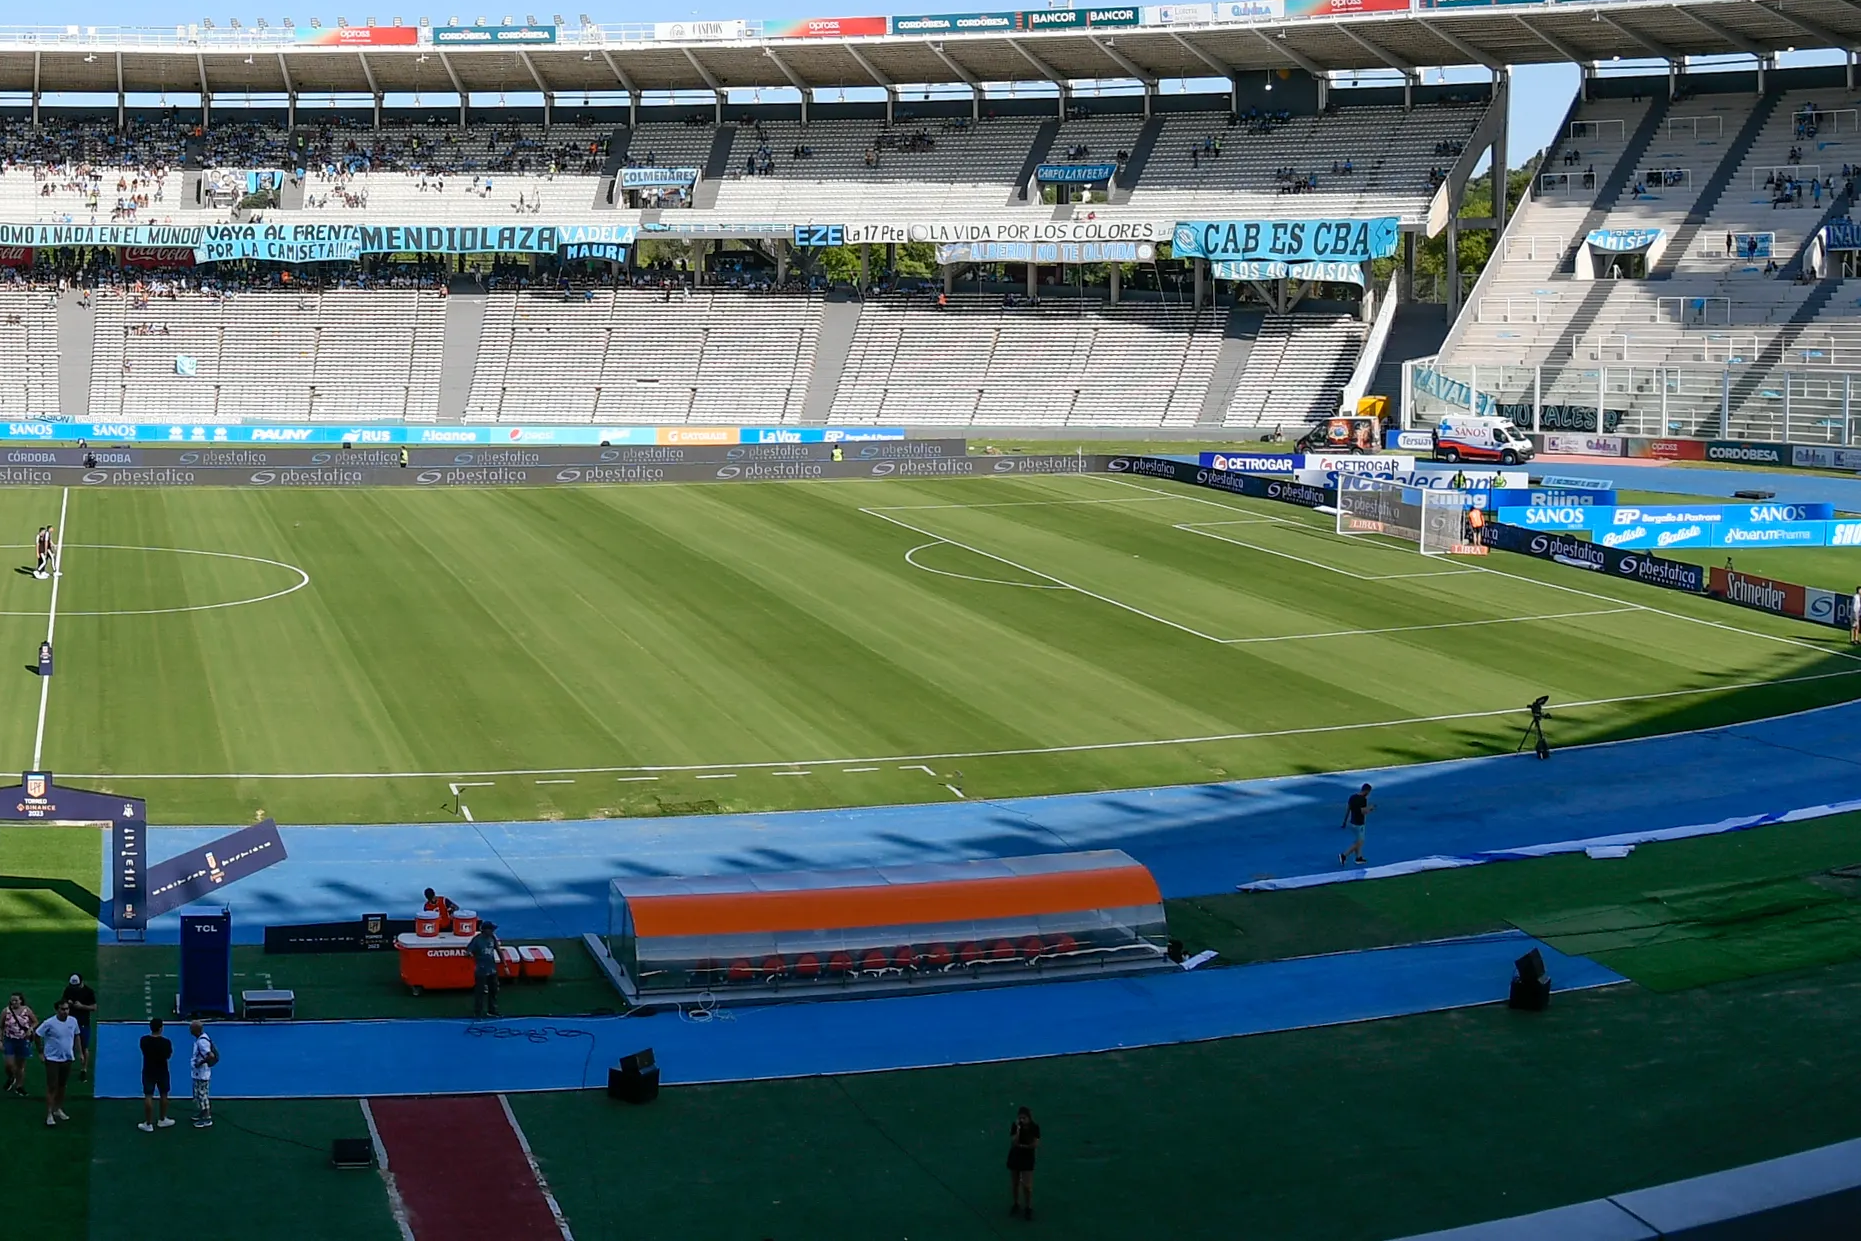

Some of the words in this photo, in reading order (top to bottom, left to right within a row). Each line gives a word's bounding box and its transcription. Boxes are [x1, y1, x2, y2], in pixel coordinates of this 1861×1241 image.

[956, 17, 1009, 28] CORDOBESA
[1032, 12, 1076, 24] BANCOR
[1091, 10, 1134, 22] BANCOR
[898, 20, 951, 30] CORDOBESA
[497, 31, 551, 40] CORDOBESA
[622, 169, 697, 185] COLMENARES
[39, 225, 48, 243] A
[53, 225, 95, 244] NADA
[148, 226, 201, 245] MUNDO
[206, 225, 256, 241] VAYA
[264, 225, 287, 241] AL
[360, 226, 554, 251] MENDIOLAZA
[795, 226, 843, 247] EZE
[845, 227, 860, 241] La
[863, 227, 877, 240] 17
[881, 227, 904, 240] Pte
[930, 226, 949, 240] LA
[955, 225, 991, 240] VIDA
[997, 225, 1029, 240] POR
[1034, 224, 1067, 240] LOS
[1072, 223, 1154, 240] COLORES
[1203, 223, 1261, 254] CAB
[1268, 222, 1305, 255] ES
[1313, 222, 1370, 255] CBA
[207, 242, 233, 259] POR
[241, 242, 259, 258] LA
[566, 243, 626, 262] MAURI
[970, 244, 1033, 261] ALBERDI
[1039, 244, 1056, 261] NO
[1061, 245, 1081, 261] TE
[1083, 244, 1137, 261] OLVIDA
[1230, 263, 1262, 278] LOS
[9, 423, 53, 436] SANOS
[92, 425, 136, 437] SANOS
[251, 428, 312, 440] PAUNY
[362, 430, 390, 442] RUS
[422, 429, 476, 442] Alcance
[1455, 426, 1487, 437] SANOS
[8, 450, 56, 462] CÓRDOBA
[478, 450, 539, 463] pbestatica
[623, 447, 684, 460] pbestatica
[749, 445, 808, 459] pbestatica
[882, 443, 941, 456] pbestatica
[1710, 447, 1778, 462] CORDOBESA
[203, 451, 266, 464] pbestatica
[335, 451, 398, 464] pbestatica
[1019, 455, 1087, 471] pbestatica
[1228, 458, 1293, 470] CETROGAR
[586, 465, 664, 480] pbestatica
[745, 462, 821, 477] pbestatica
[900, 458, 973, 474] pbestatica
[1133, 457, 1175, 475] pbestatica
[1335, 460, 1399, 472] CETROGAR
[113, 467, 195, 482] pbestatica
[281, 467, 362, 482] pbestatica
[447, 467, 527, 482] pbestatica
[1209, 471, 1244, 489] pbestatica
[1282, 484, 1324, 503] pbestatica
[1526, 508, 1584, 523] SANOS
[1750, 506, 1806, 522] SANOS
[1550, 537, 1605, 564] pbestatica
[1639, 560, 1696, 585] pbestatica
[1727, 572, 1786, 611] Schneider
[195, 924, 218, 933] TCL
[427, 949, 470, 958] GATORAD
